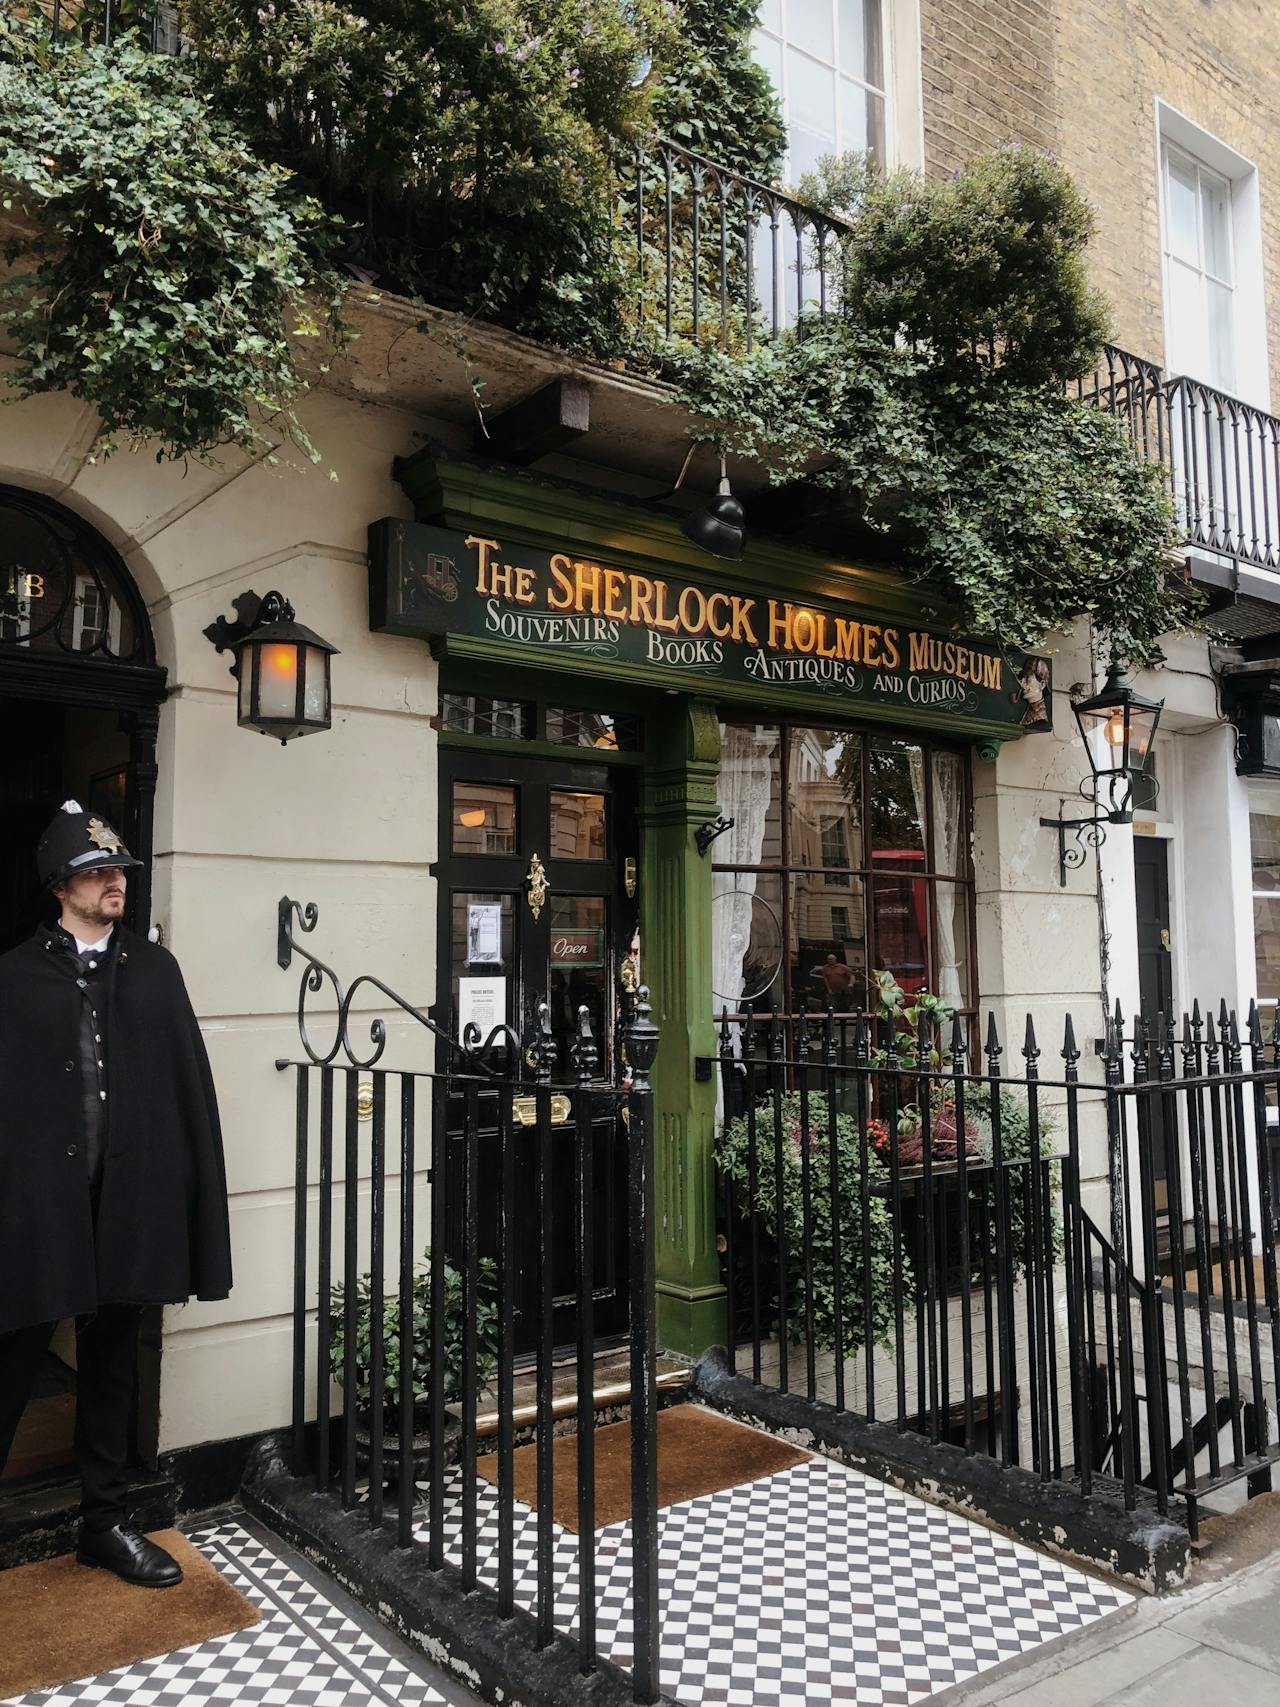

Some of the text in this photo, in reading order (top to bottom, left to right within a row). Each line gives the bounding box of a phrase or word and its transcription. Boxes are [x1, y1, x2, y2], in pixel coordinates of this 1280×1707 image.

[465, 534, 1003, 690] THE SHERLOCK HOLMES MUSEUM
[485, 598, 966, 704] SOUVENIRS BOOKS ANTIQUES AND CURIOS
[553, 938, 589, 957] Open
